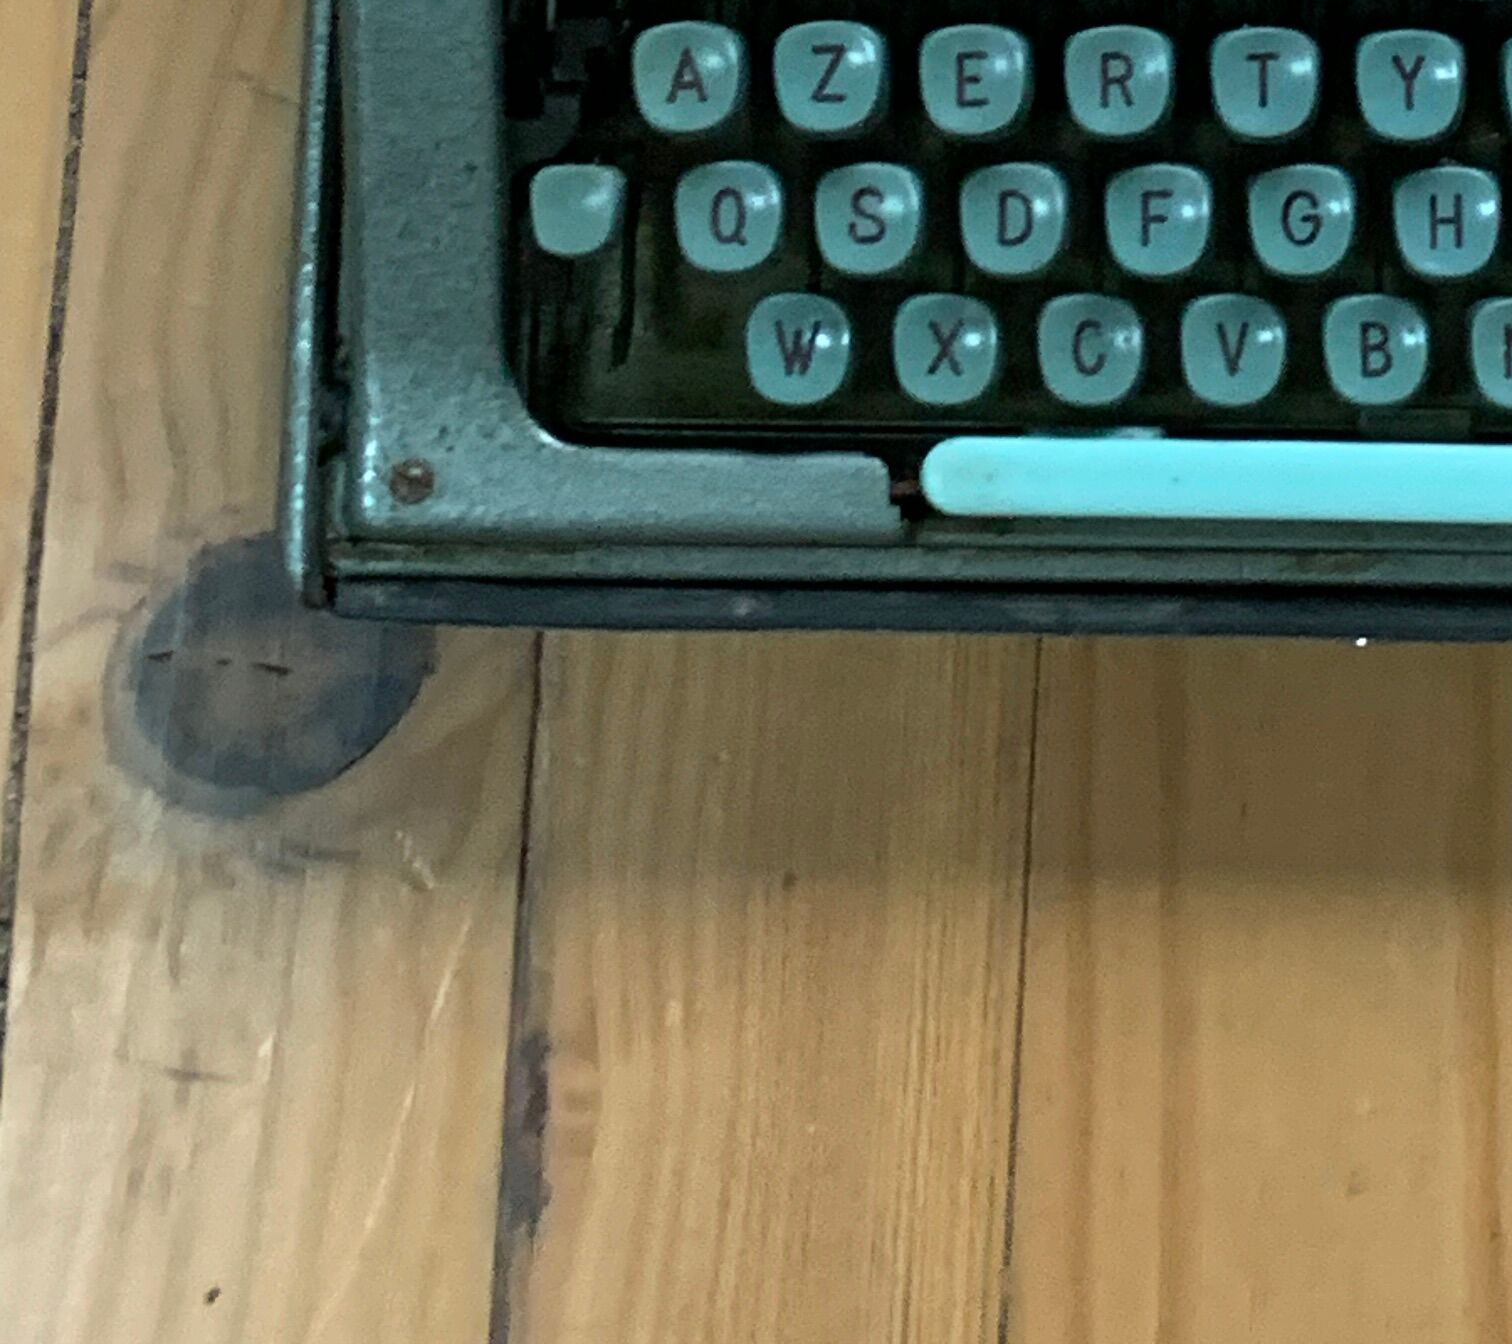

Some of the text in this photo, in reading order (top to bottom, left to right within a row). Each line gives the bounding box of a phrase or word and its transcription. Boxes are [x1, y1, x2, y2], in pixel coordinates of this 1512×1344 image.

[665, 47, 708, 104] A
[811, 43, 846, 103] Z
[956, 50, 990, 108] E
[1099, 52, 1134, 109] R
[1246, 52, 1280, 108] T
[1391, 54, 1425, 111] Y
[710, 187, 748, 247] Q
[847, 187, 887, 245] S
[997, 189, 1034, 247] D
[1140, 189, 1173, 247] F
[1281, 190, 1323, 247] G
[1429, 193, 1463, 250] H
[774, 319, 821, 376] W
[926, 319, 965, 376] X
[1071, 320, 1107, 376] C
[1217, 322, 1249, 376] V
[1360, 322, 1393, 377] B
